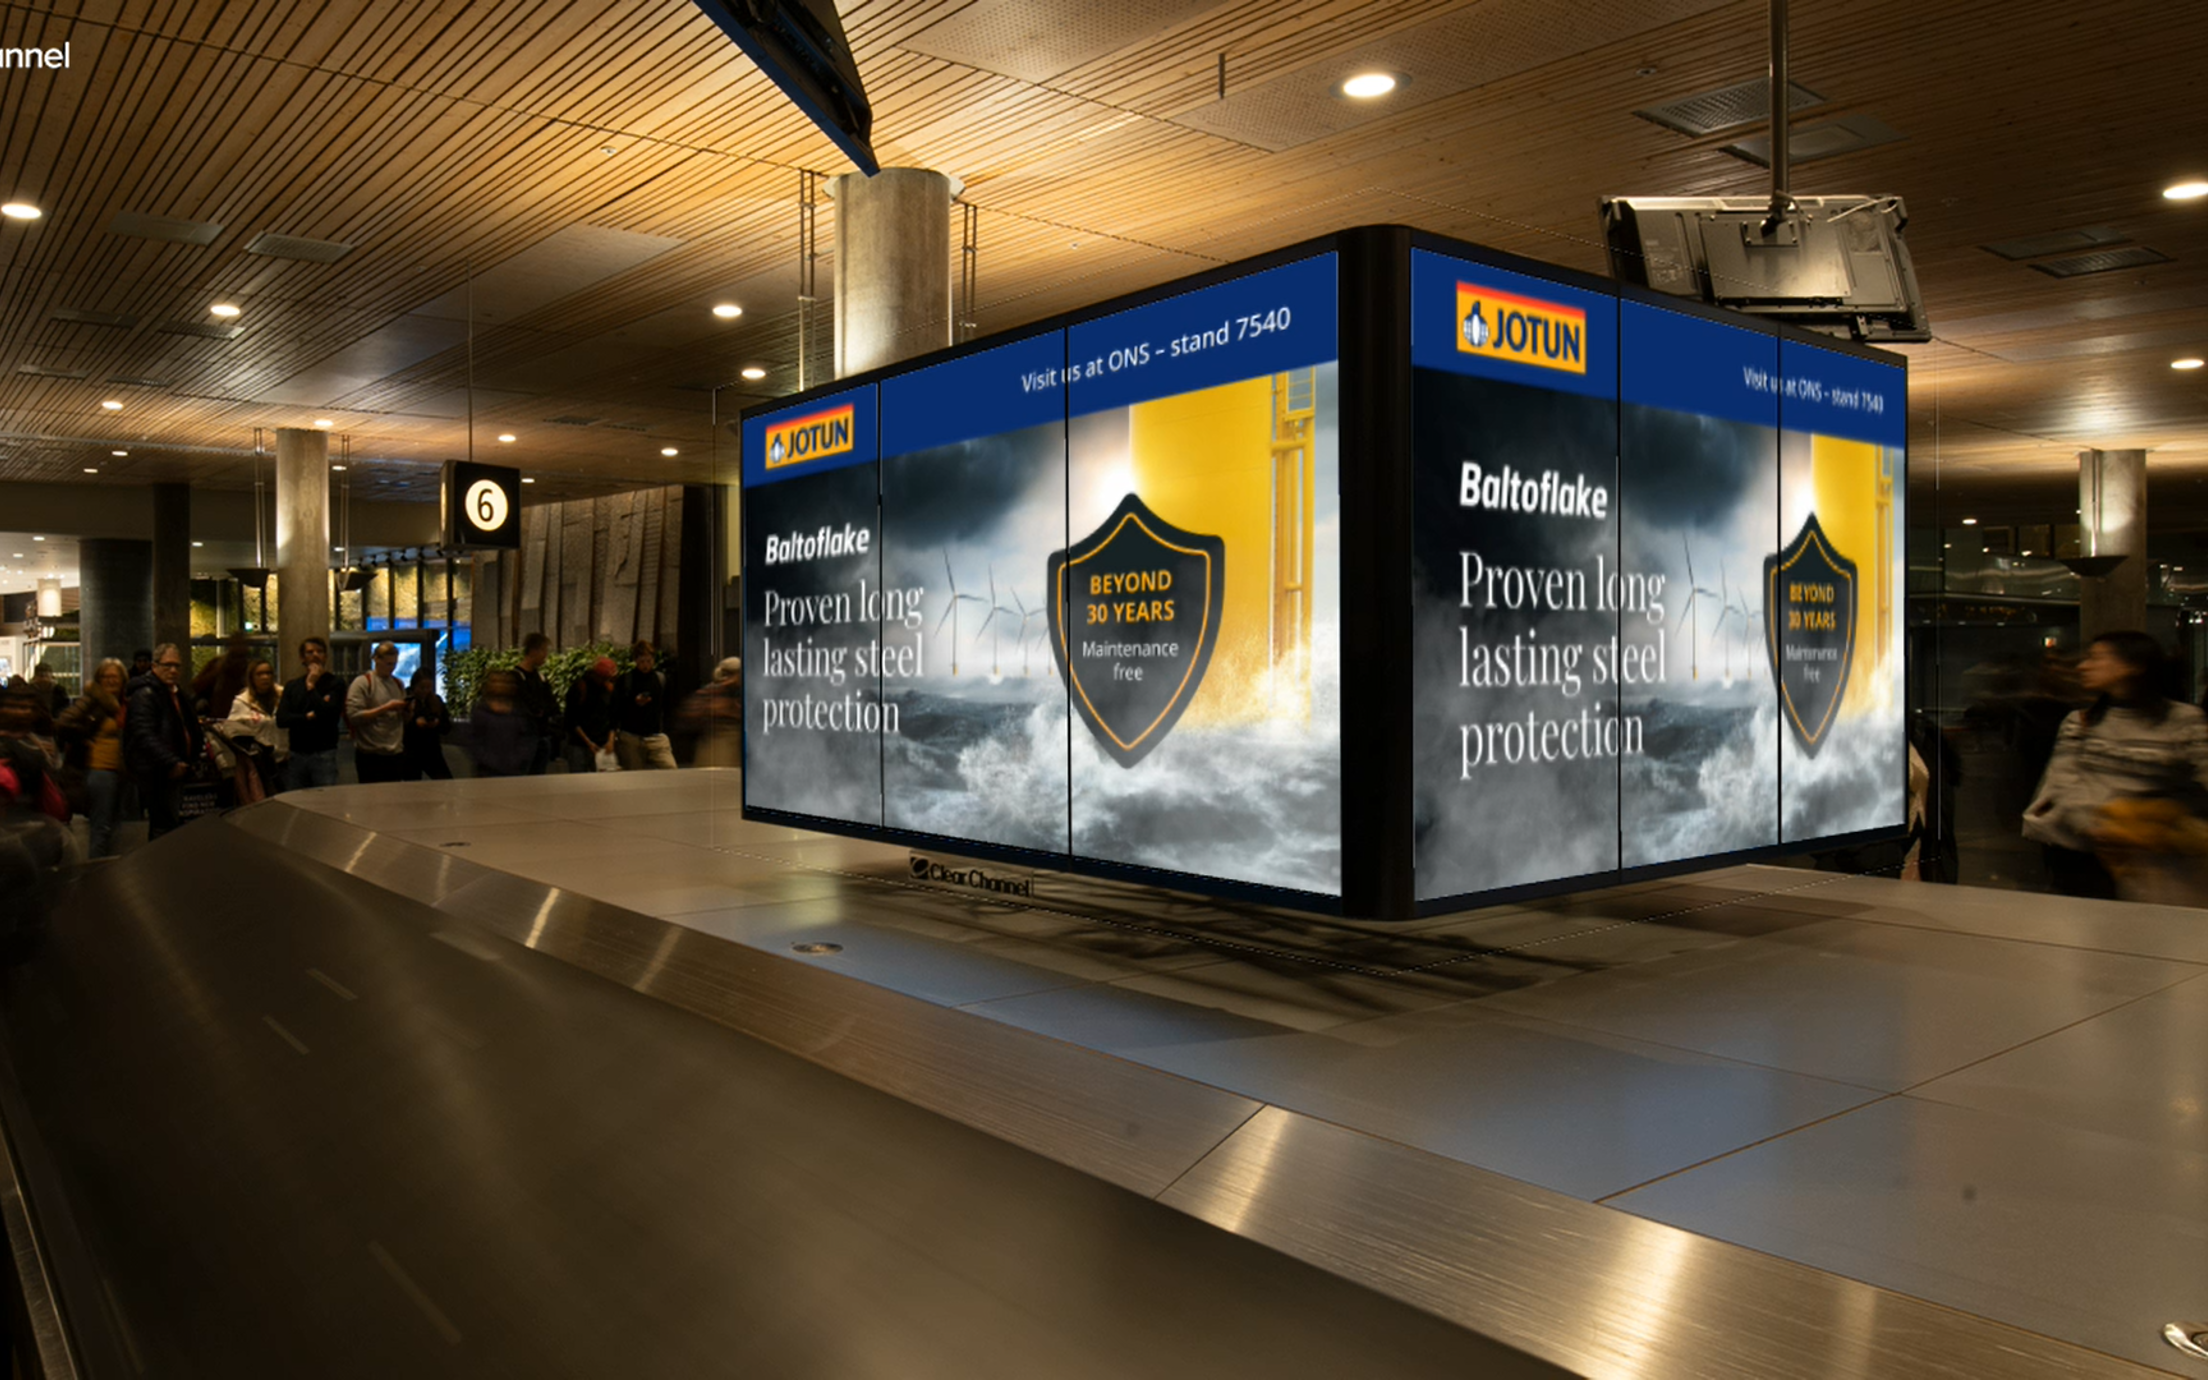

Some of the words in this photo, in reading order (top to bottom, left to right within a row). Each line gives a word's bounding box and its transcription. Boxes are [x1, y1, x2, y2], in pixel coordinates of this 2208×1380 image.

[1021, 369, 1056, 393] Visit
[1061, 364, 1081, 383] us
[1085, 357, 1103, 378] at
[1108, 343, 1150, 371] ONS
[1170, 321, 1229, 357] stand
[1236, 306, 1291, 341] 7540
[1493, 309, 1580, 363] JOTUN
[1798, 376, 1822, 402] ONS
[787, 416, 849, 459] JOTUN
[477, 488, 494, 522] 6
[1460, 460, 1608, 519] Baltoflake
[765, 522, 870, 566] Baltoflake
[764, 590, 851, 627] Proven
[859, 578, 924, 629] long
[1090, 570, 1173, 595] BEYOND
[1459, 551, 1587, 611] Proven
[1597, 554, 1666, 624] long
[1789, 583, 1835, 604] BEYOND
[1087, 603, 1108, 625] 30
[1113, 600, 1175, 623] YEARS
[1804, 610, 1836, 631] YEARS
[763, 637, 847, 686] lasting
[855, 632, 924, 677] steel
[1083, 640, 1179, 657] Maintenance
[1459, 625, 1582, 697] lasting
[1593, 627, 1667, 685] steel
[1113, 662, 1143, 681] free
[763, 689, 899, 735] protection
[1459, 702, 1643, 780] protection
[930, 863, 966, 885] Clear
[969, 869, 1029, 897] Channel
